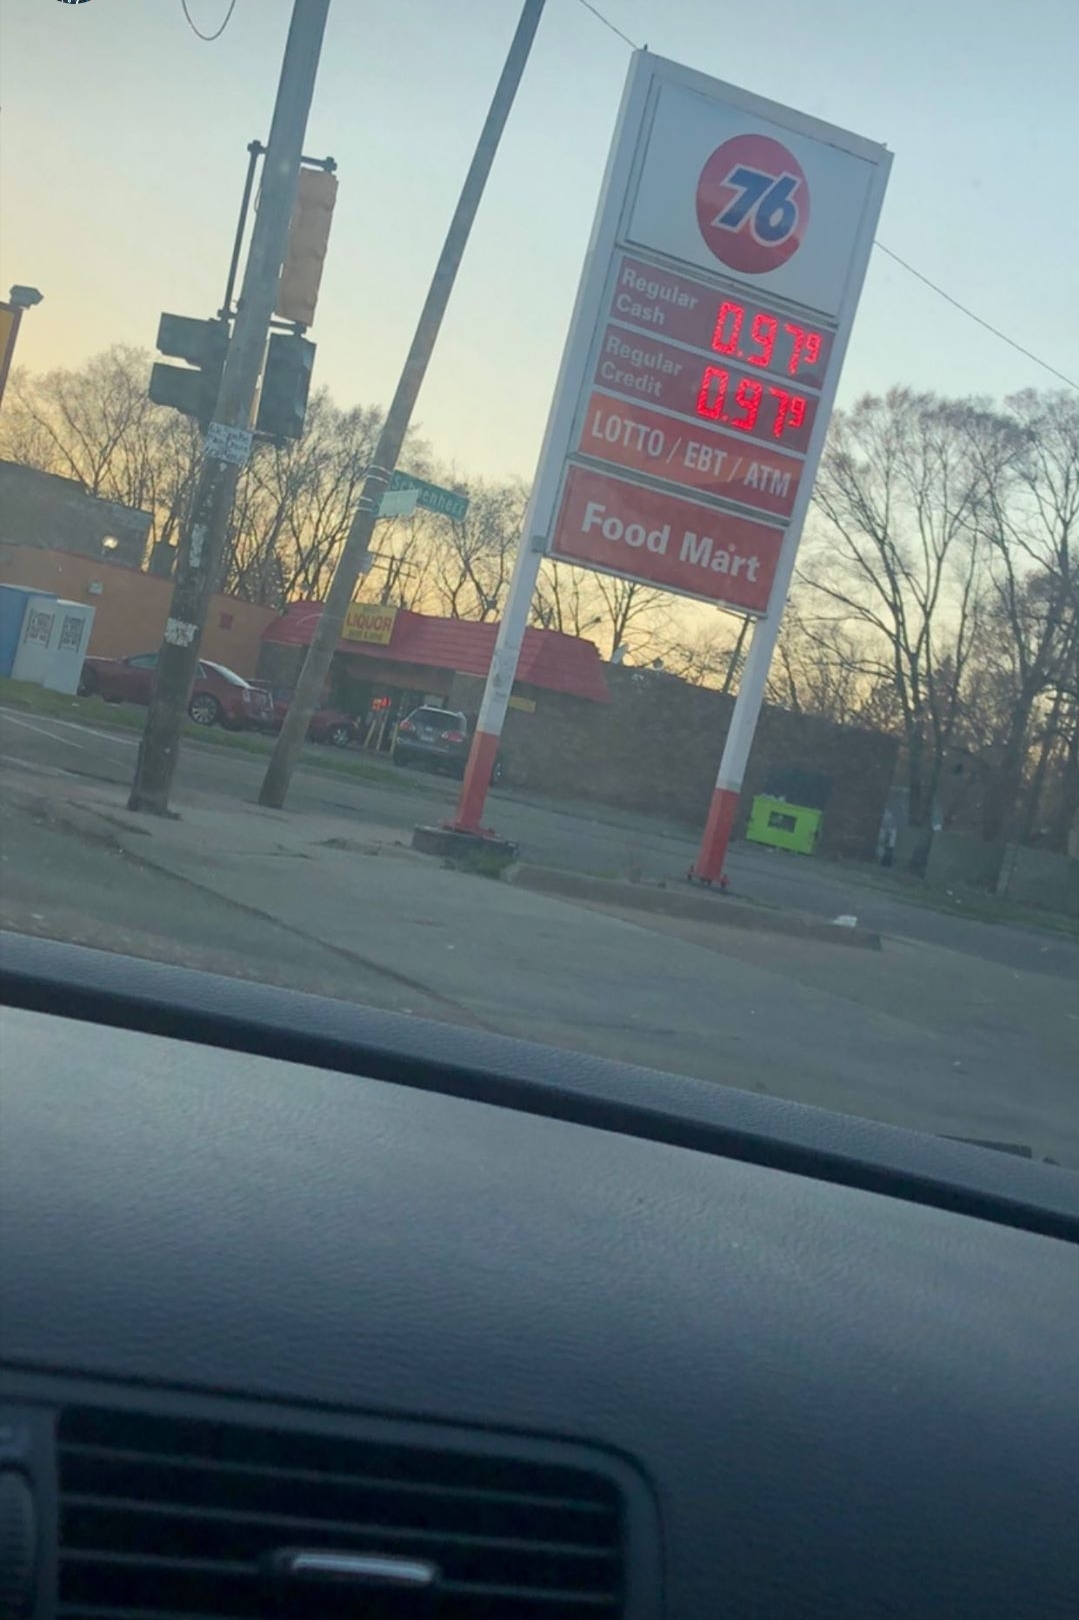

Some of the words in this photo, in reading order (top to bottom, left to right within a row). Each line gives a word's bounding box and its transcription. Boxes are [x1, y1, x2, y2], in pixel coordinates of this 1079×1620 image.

[711, 163, 801, 247] 76
[616, 293, 666, 326] Cash
[621, 267, 699, 311] Regular
[606, 334, 683, 377] Regular
[600, 361, 663, 398] Credit
[591, 409, 665, 458] LOTTO
[683, 441, 729, 477] EBT
[743, 462, 792, 498] ATM
[580, 501, 671, 556] Food
[679, 531, 761, 583] Mart
[346, 612, 393, 632] LIQUOR
